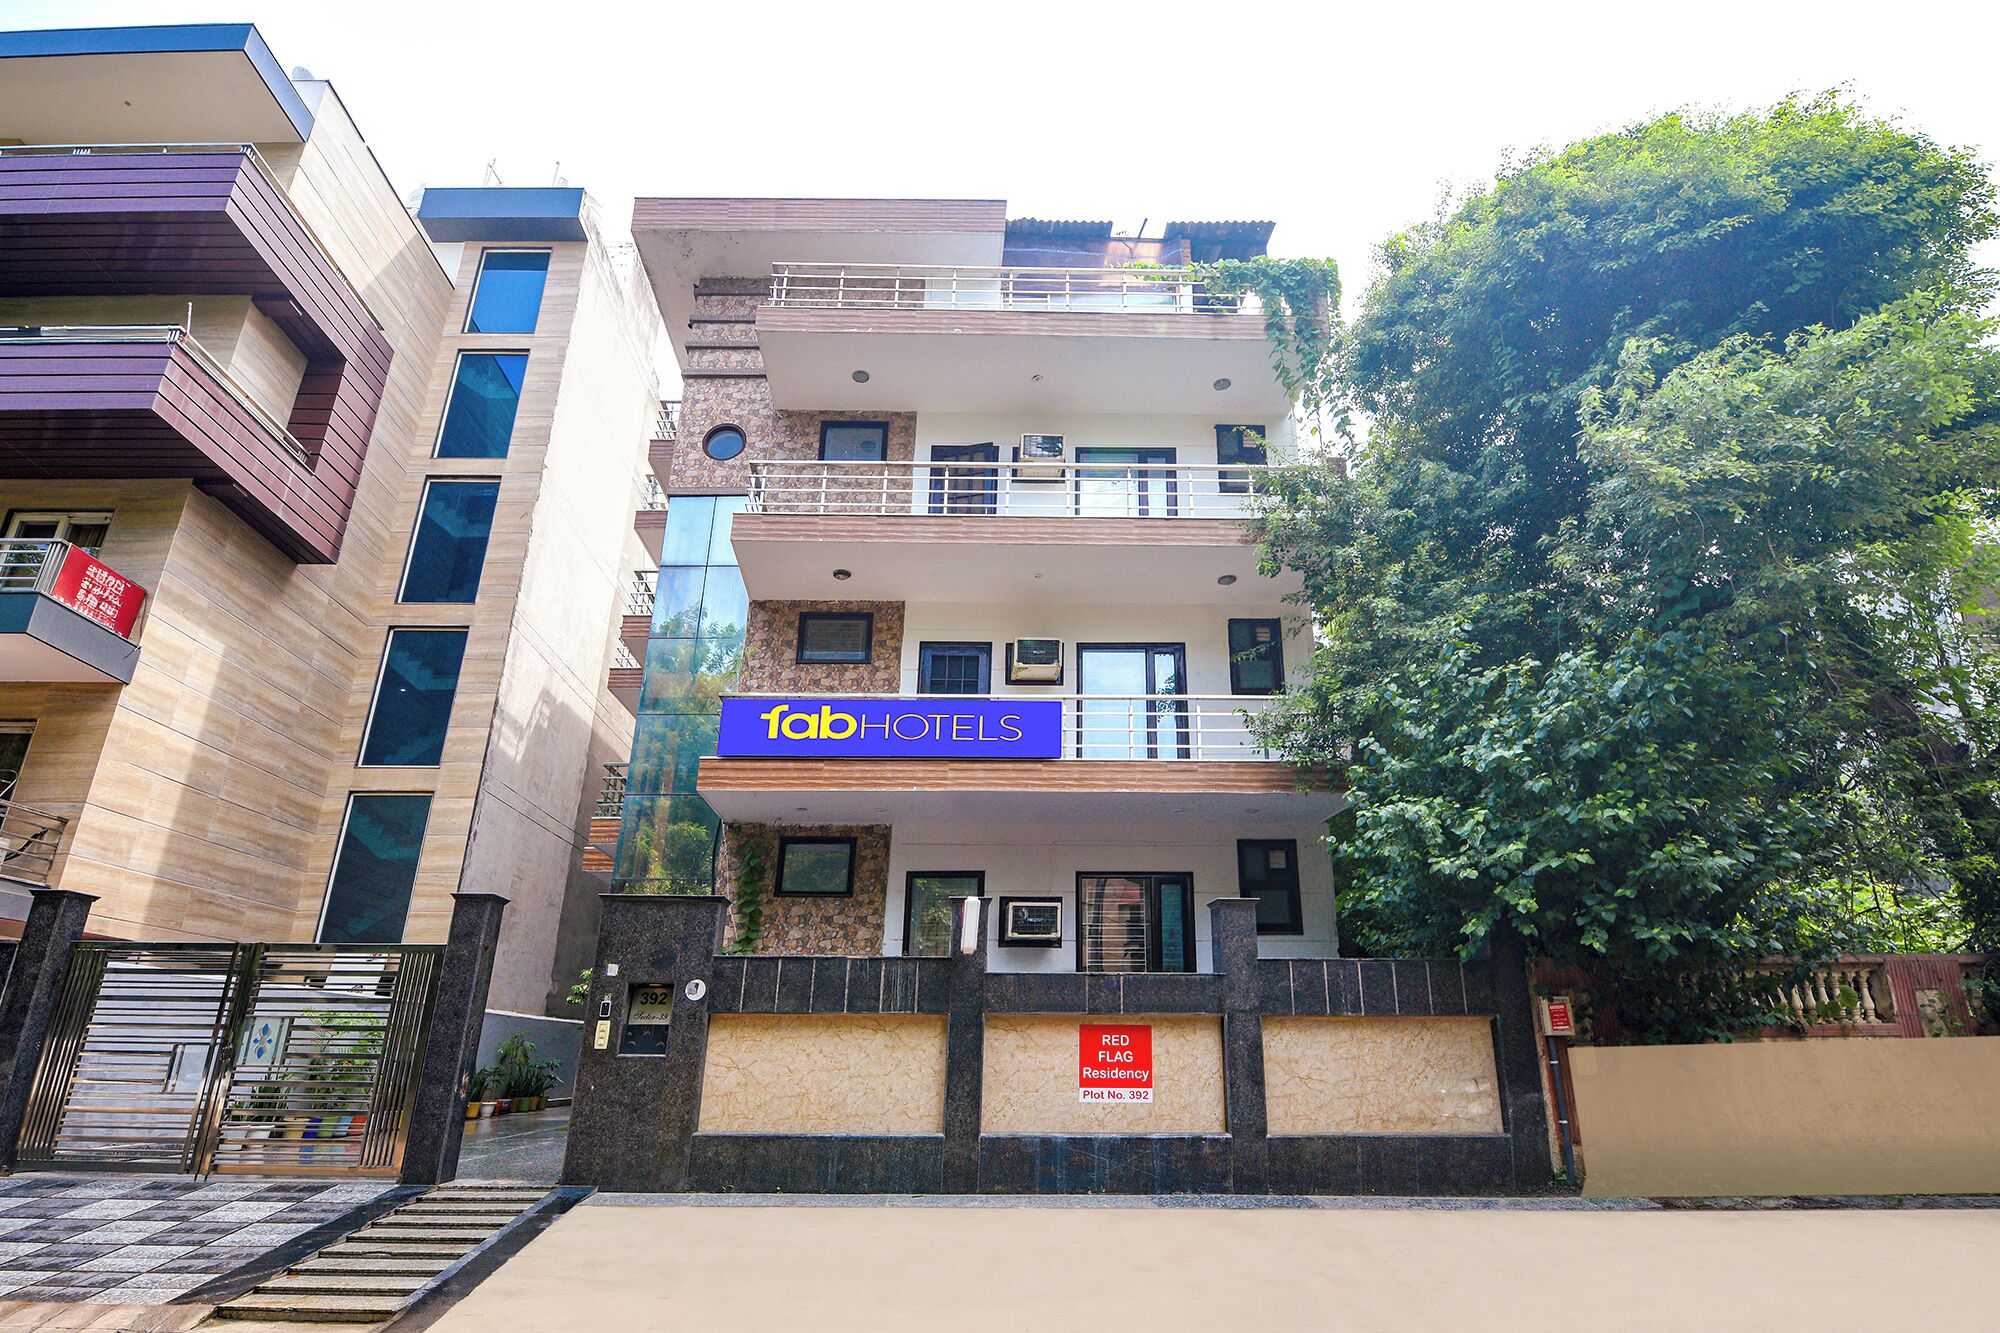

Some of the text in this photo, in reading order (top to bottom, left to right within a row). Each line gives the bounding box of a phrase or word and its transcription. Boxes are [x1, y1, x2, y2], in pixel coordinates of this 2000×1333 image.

[640, 992, 668, 1005] 392
[1102, 1034, 1130, 1046] RED
[1098, 1050, 1134, 1063] FLAG
[1082, 1066, 1150, 1082] Residency
[1082, 1090, 1149, 1100] Plot No. 392
